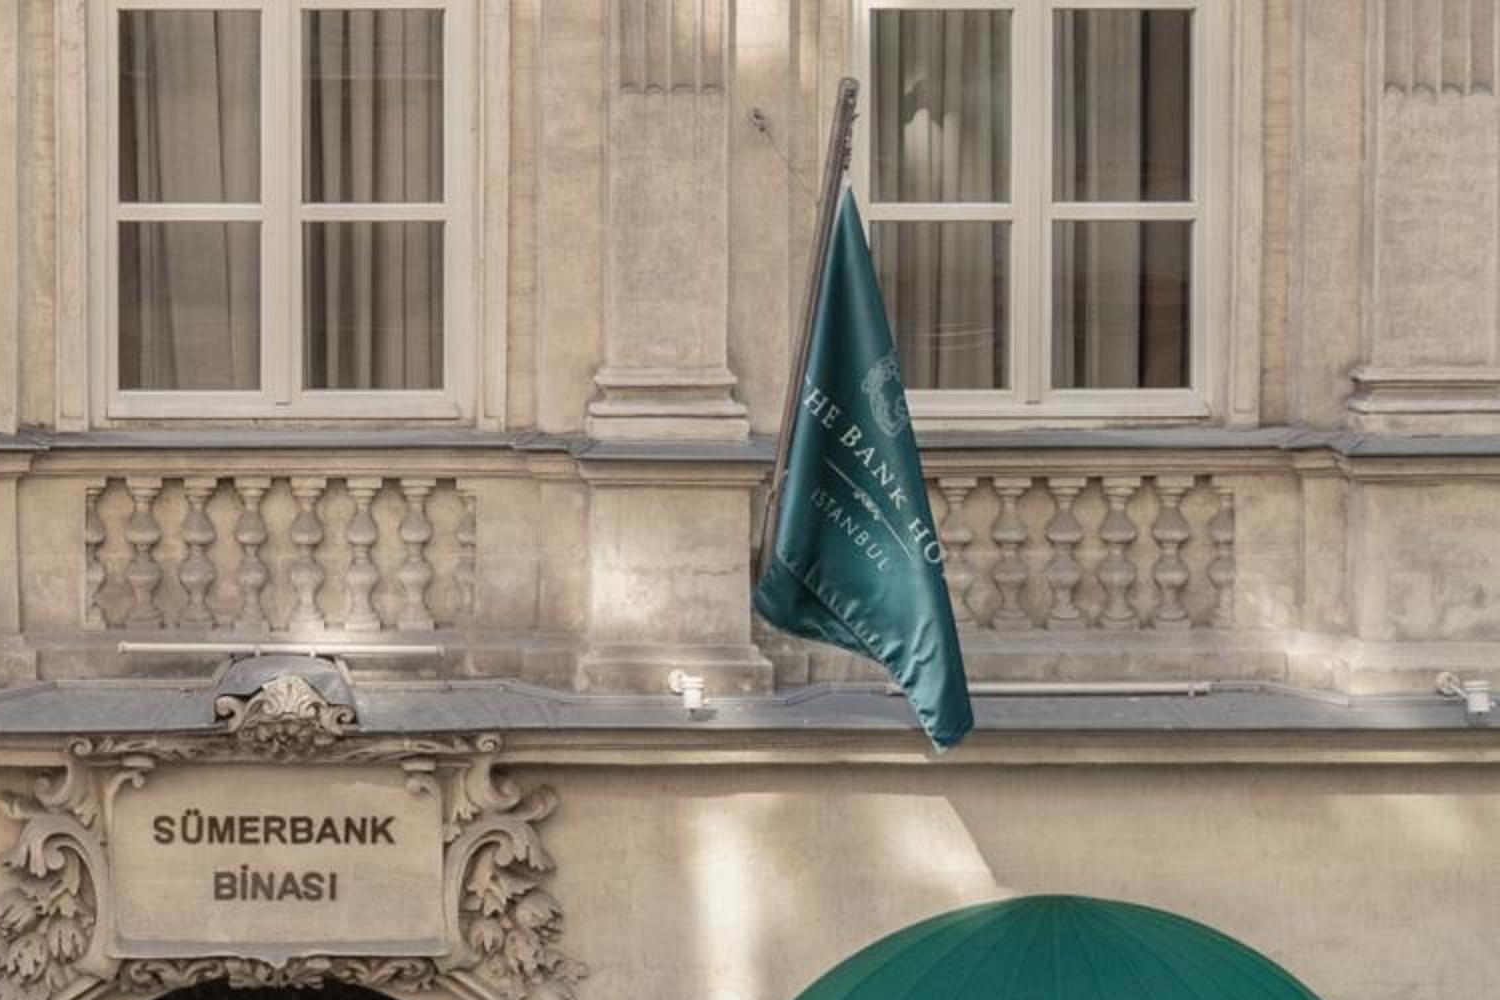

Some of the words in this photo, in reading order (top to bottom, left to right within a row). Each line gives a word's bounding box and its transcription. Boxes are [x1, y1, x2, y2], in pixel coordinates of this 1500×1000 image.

[803, 374, 841, 429] HE
[839, 425, 908, 511] BANK
[907, 516, 944, 564] HO
[152, 808, 397, 845] SÜMERBANK
[213, 864, 337, 901] BİNASI
